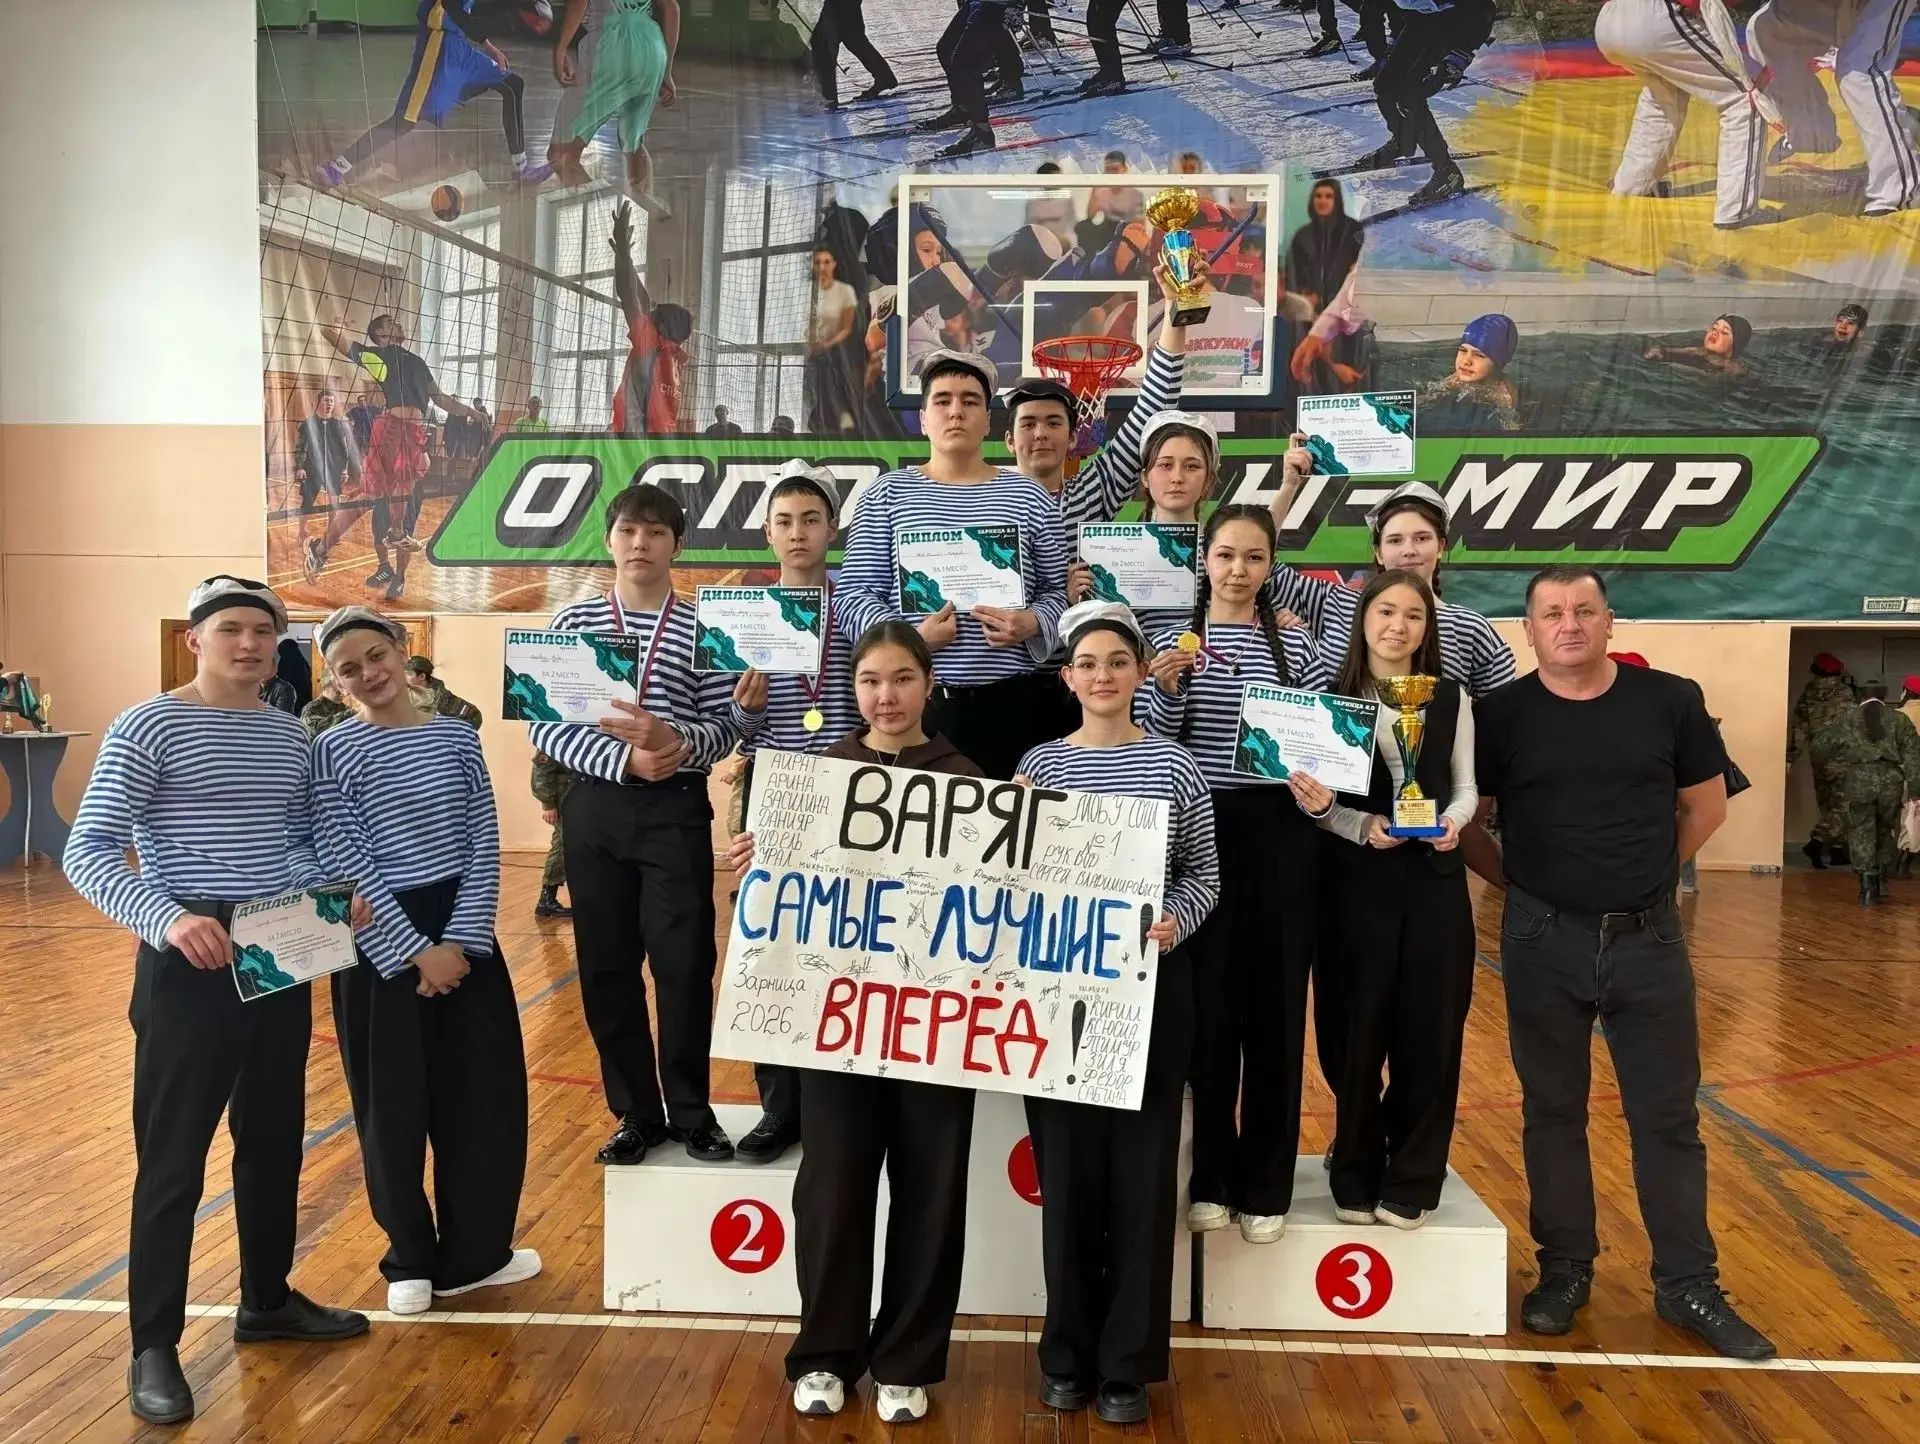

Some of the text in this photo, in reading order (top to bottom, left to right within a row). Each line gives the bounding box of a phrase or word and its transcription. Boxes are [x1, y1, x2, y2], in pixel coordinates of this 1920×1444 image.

[1301, 398, 1360, 411] ДИПЛОМ
[503, 463, 593, 528] О
[1440, 462, 1742, 531] МИР
[900, 531, 963, 545] ДИПЛОМ
[1082, 526, 1143, 538] ДИПЛОМ
[701, 590, 765, 601] ДИПЛОМ
[508, 632, 579, 646] ДИПЛОМ
[556, 672, 580, 680] МЕСТО
[1247, 686, 1316, 707] ДИПЛОМ
[1290, 730, 1315, 739] МЕСТО
[770, 753, 823, 773] АЙРАТ
[767, 772, 815, 792] АРИНА
[758, 808, 815, 832] ДАНИЯР
[839, 765, 1068, 869] ВАРЯГ
[1110, 830, 1122, 856] 1
[757, 847, 793, 867] УРАЛ
[237, 893, 304, 919] ДИПЛОМ
[738, 869, 905, 951] САМЫЕ
[733, 962, 806, 998] Зарница
[730, 1001, 794, 1034] 2026
[1089, 999, 1142, 1022] КИРИЛЛ
[815, 976, 1049, 1079] ВПЕРЁД
[1081, 1035, 1141, 1057] ТИМУР
[1084, 1052, 1127, 1073] ЗИЛЯ
[1077, 1084, 1127, 1105] САБИНА
[728, 1204, 765, 1262] 2
[1332, 1250, 1372, 1309] 3
